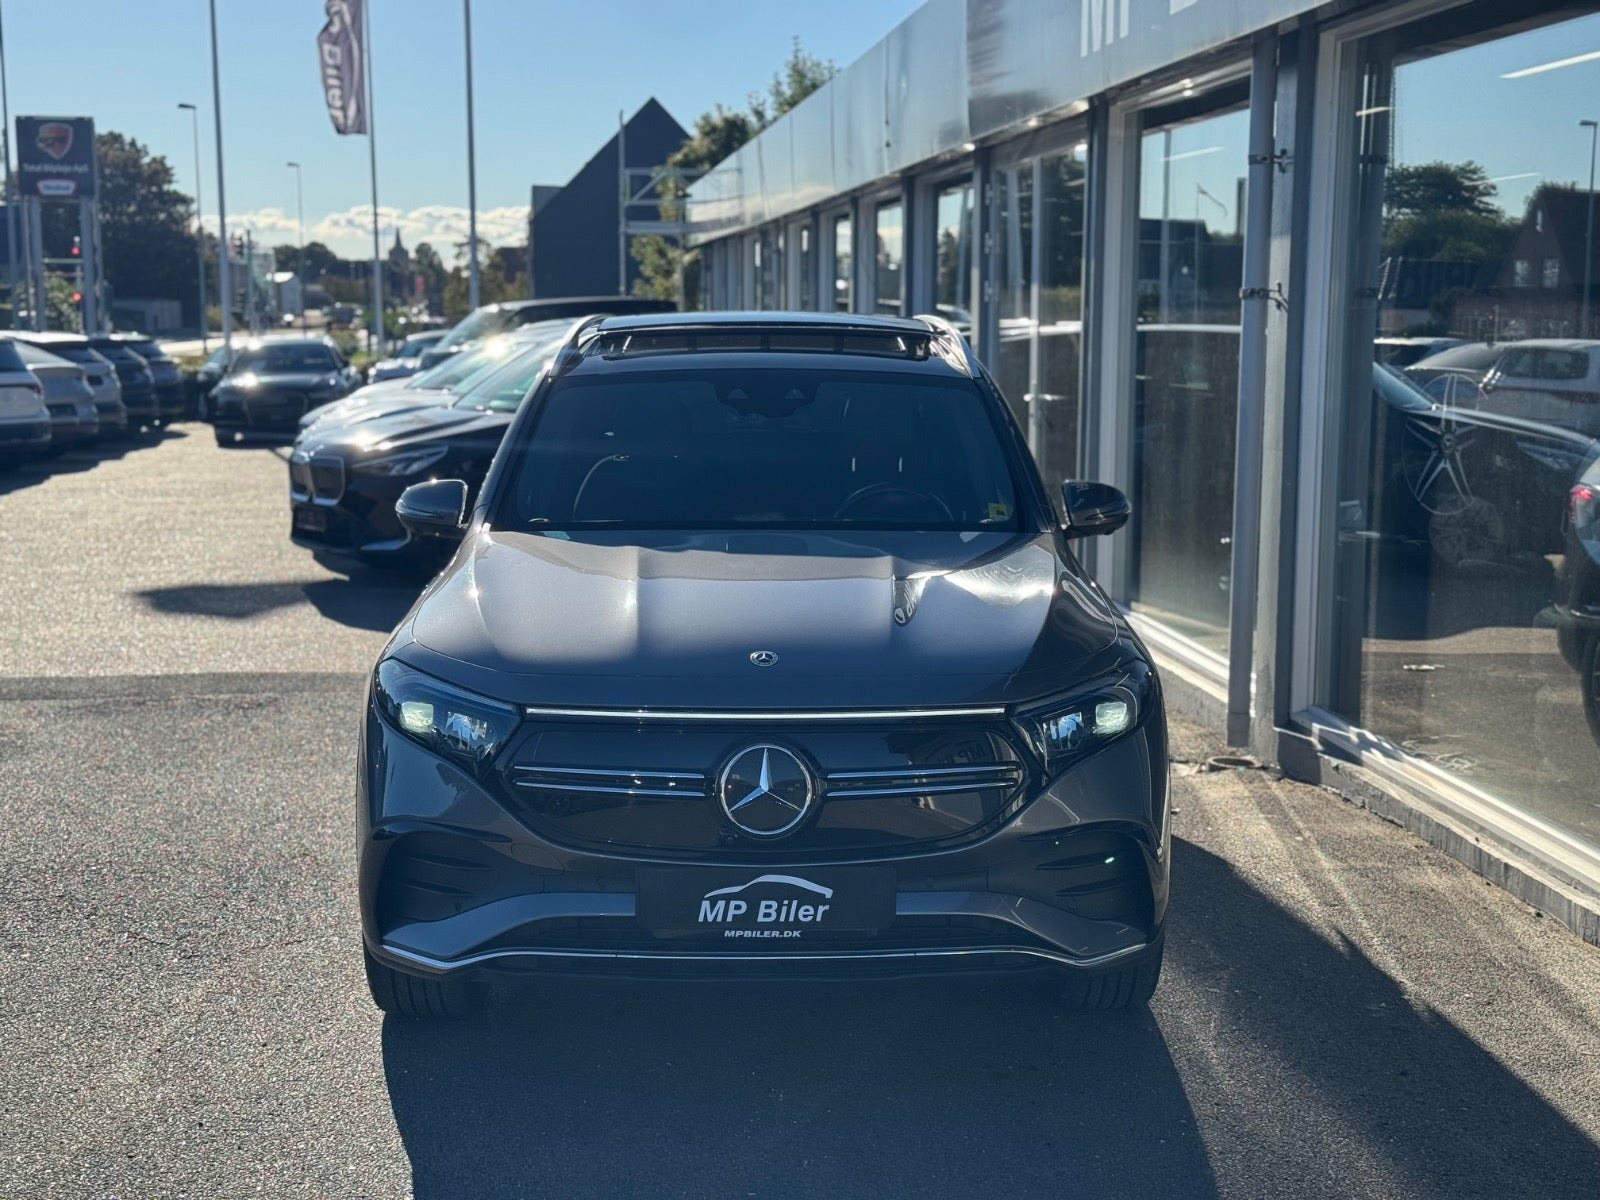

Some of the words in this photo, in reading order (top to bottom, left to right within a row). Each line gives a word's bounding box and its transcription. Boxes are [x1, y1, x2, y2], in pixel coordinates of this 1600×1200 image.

[1080, 0, 1130, 58] M
[698, 900, 747, 923] MP
[757, 899, 830, 923] Biler
[724, 930, 802, 938] MPBILER.DK
